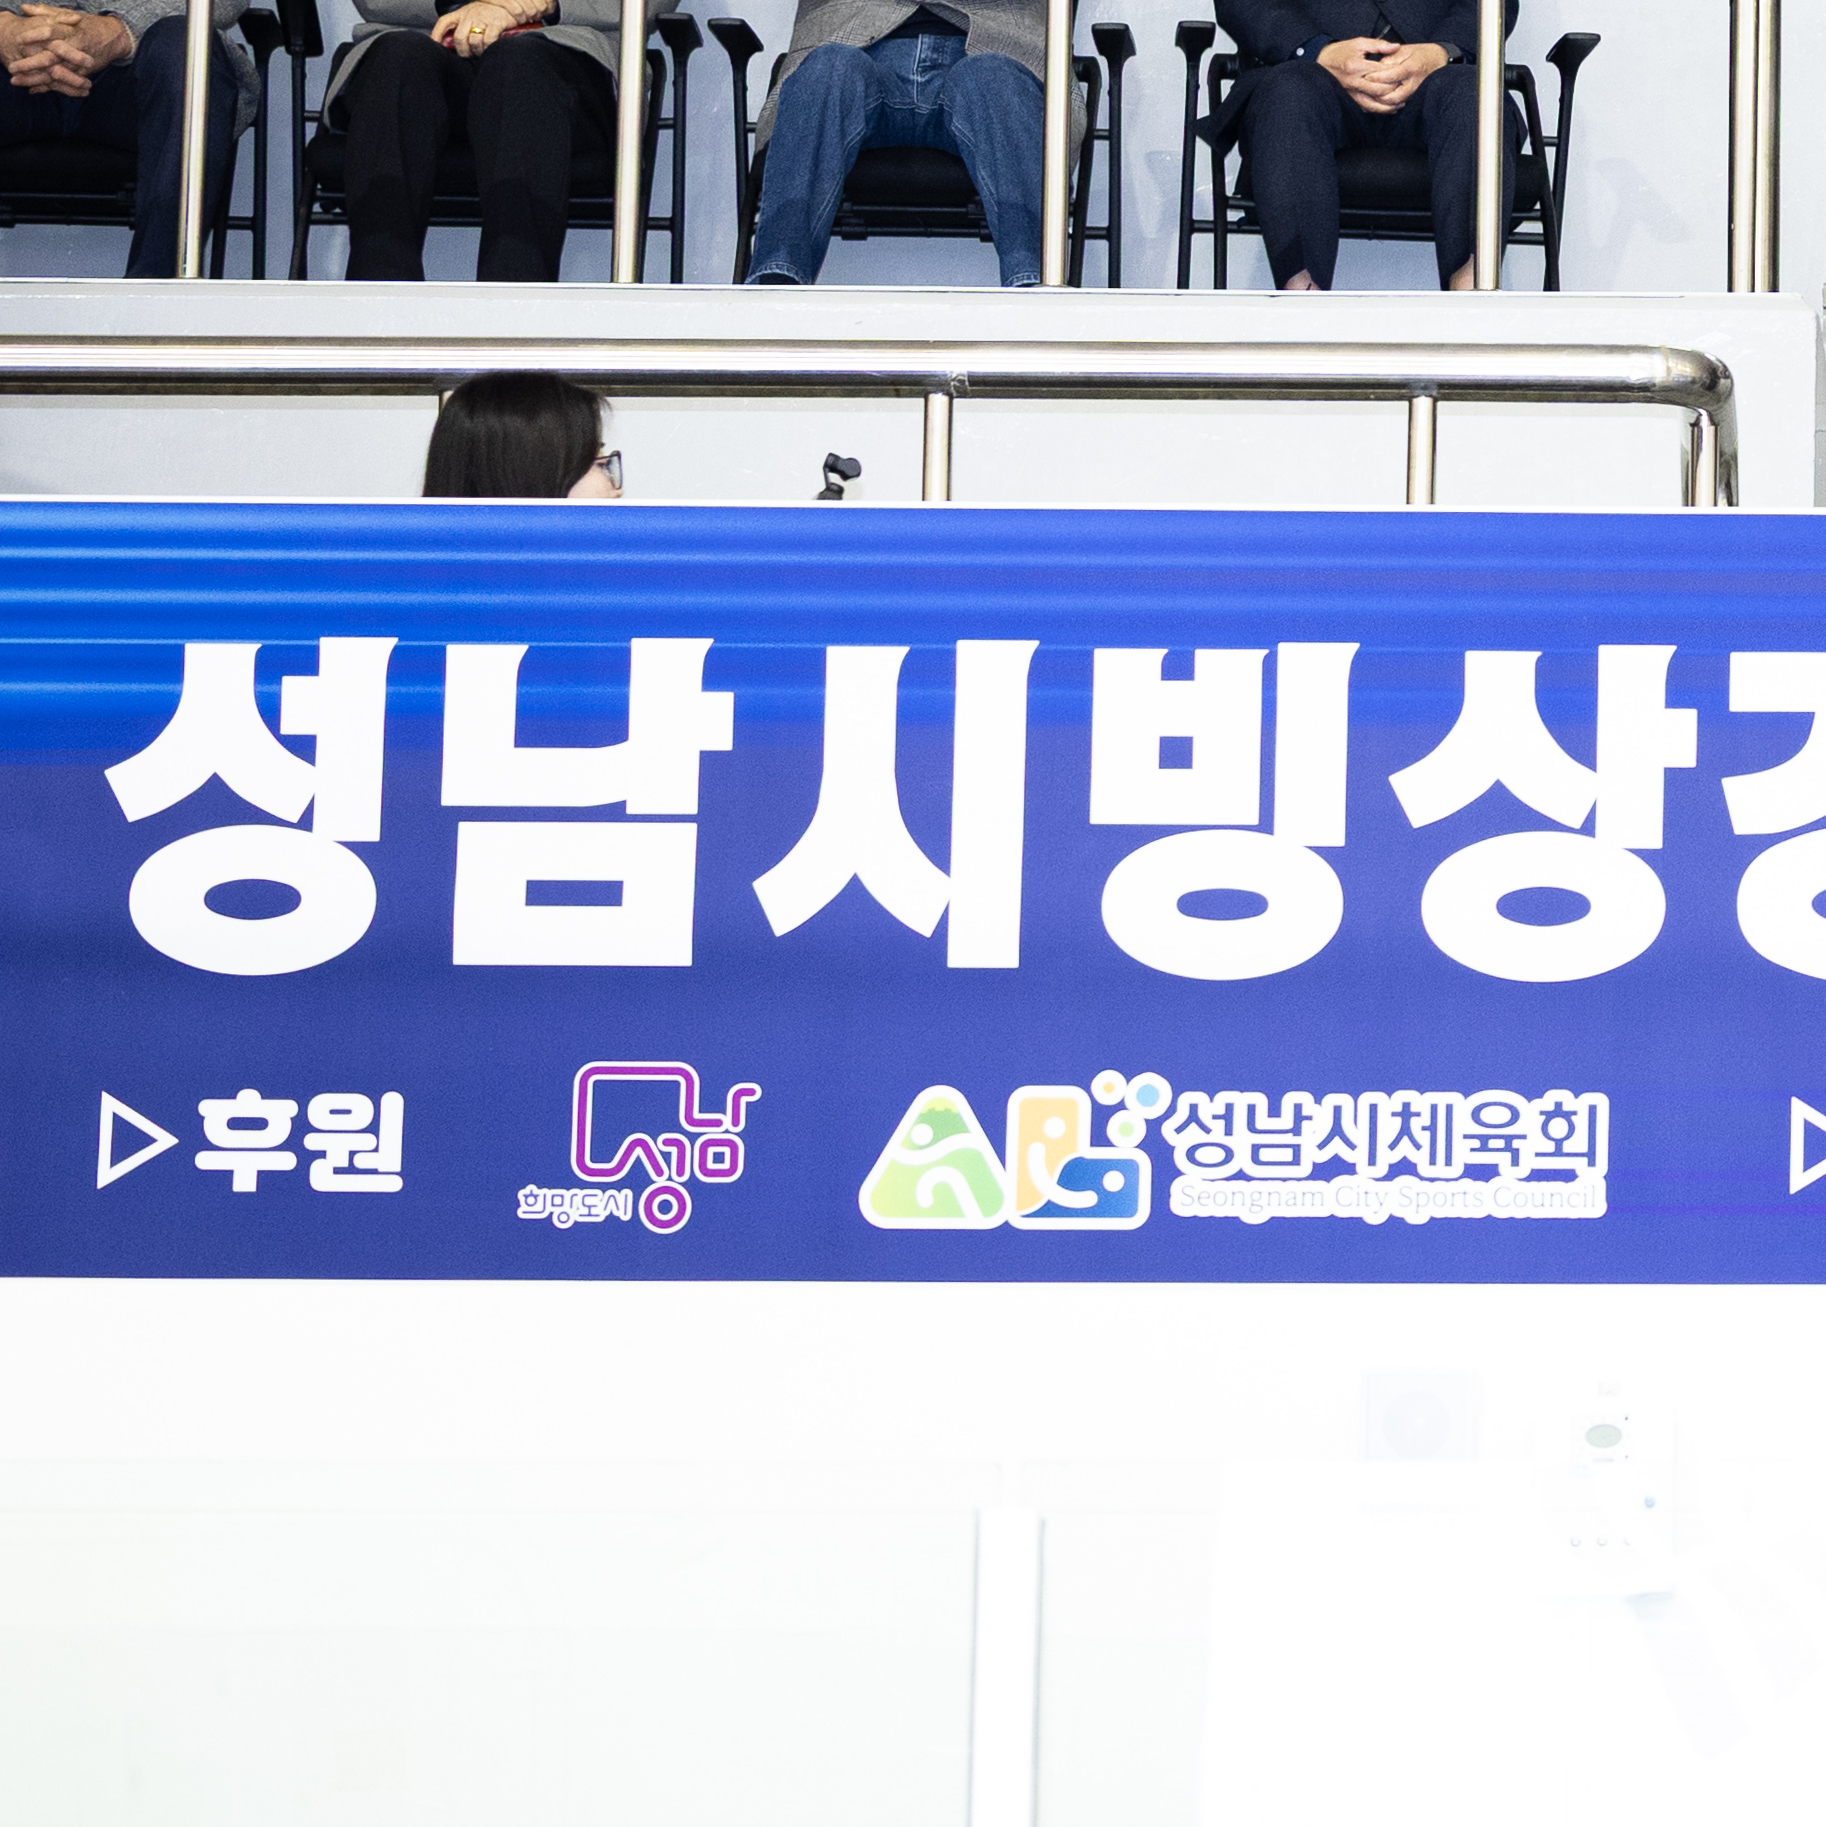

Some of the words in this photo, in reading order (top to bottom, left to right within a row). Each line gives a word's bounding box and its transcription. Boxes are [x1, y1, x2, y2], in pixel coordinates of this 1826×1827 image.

[195, 1088, 404, 1192] 후원
[1170, 1098, 1600, 1172] 성남시체육회
[519, 1186, 631, 1227] 희망도시
[1180, 1183, 1325, 1213] Seongnam
[1334, 1183, 1390, 1213] City
[1397, 1183, 1485, 1214] Sports
[1492, 1184, 1597, 1209] Council
